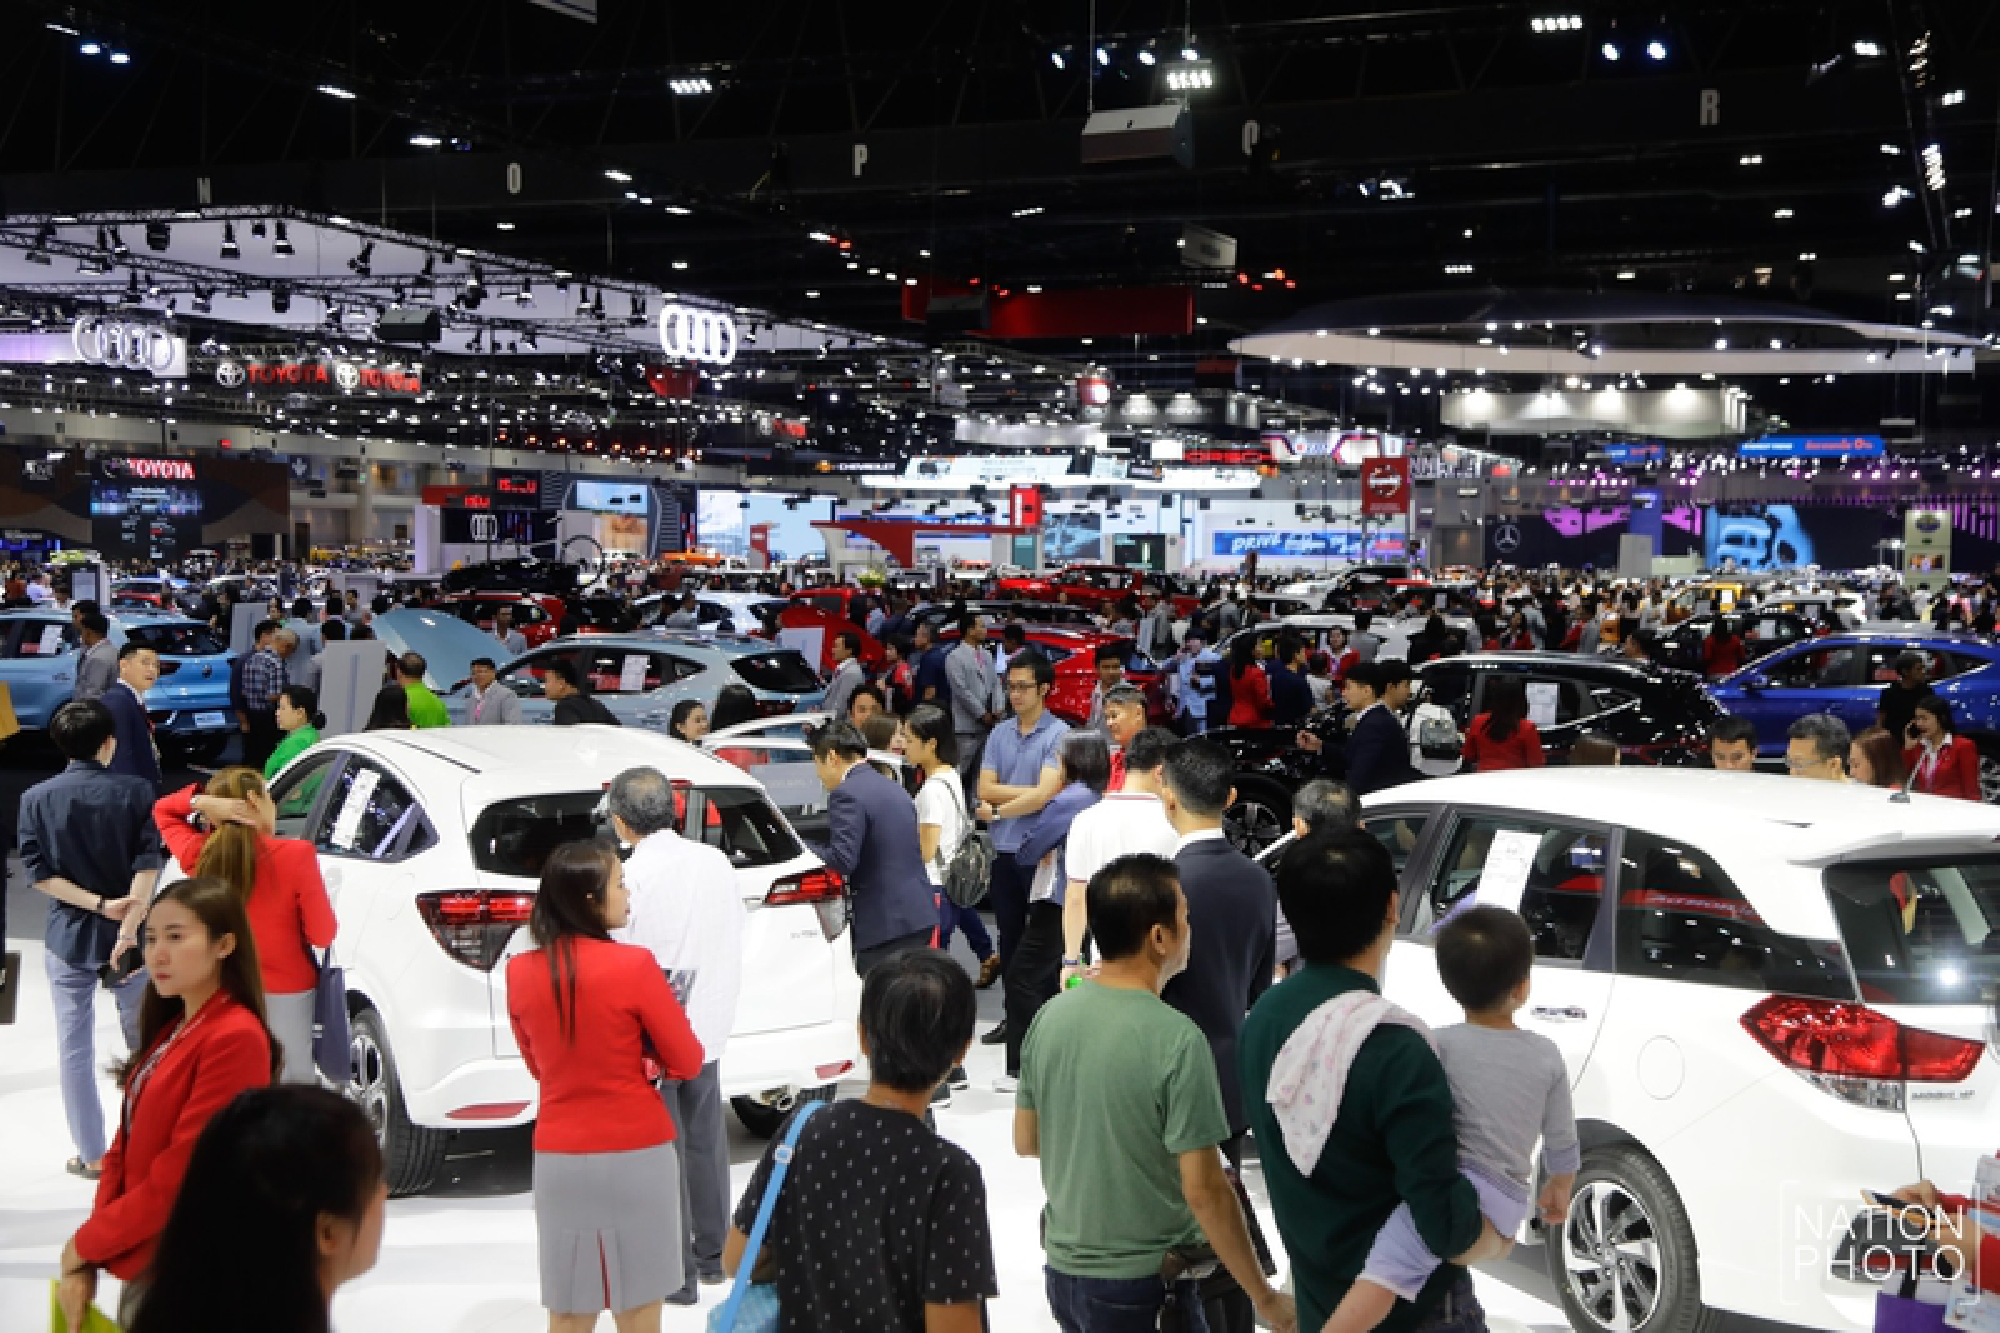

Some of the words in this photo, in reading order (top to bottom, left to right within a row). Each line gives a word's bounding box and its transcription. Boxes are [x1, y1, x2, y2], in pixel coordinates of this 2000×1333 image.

[1700, 89, 1720, 126] R
[506, 161, 522, 194] O
[852, 144, 869, 178] P
[247, 363, 330, 385] TOYOTA
[126, 457, 196, 480] TOYOTA
